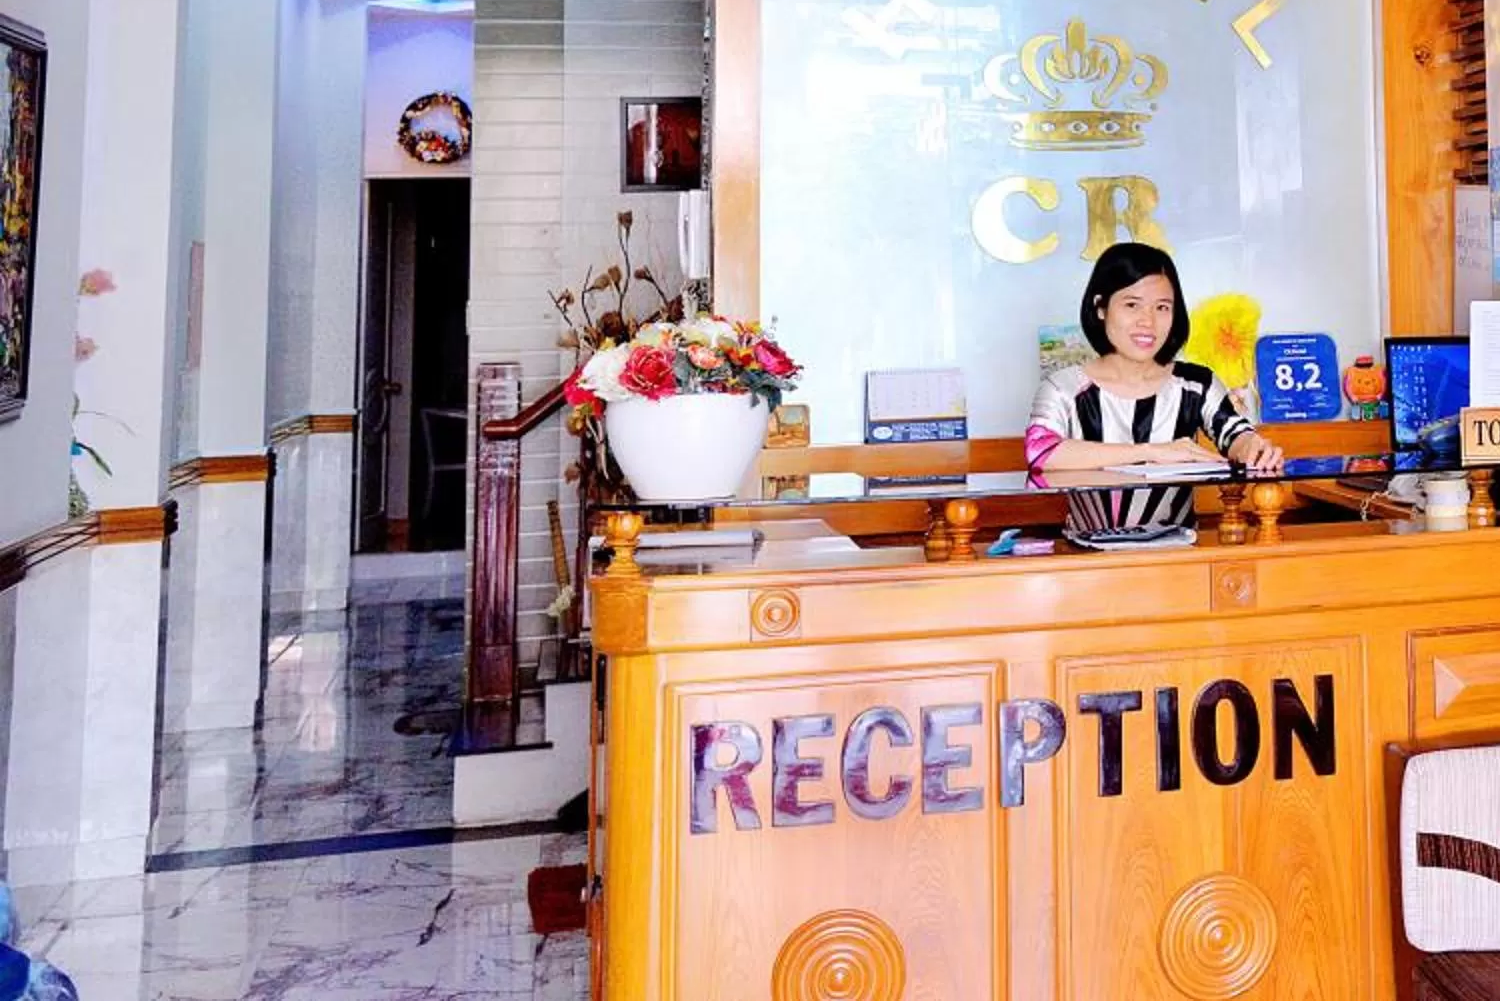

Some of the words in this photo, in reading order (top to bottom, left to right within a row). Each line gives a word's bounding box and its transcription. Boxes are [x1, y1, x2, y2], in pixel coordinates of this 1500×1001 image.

[970, 176, 1177, 265] CR
[1276, 363, 1322, 392] 8,2
[689, 675, 1337, 835] RECEPTION
